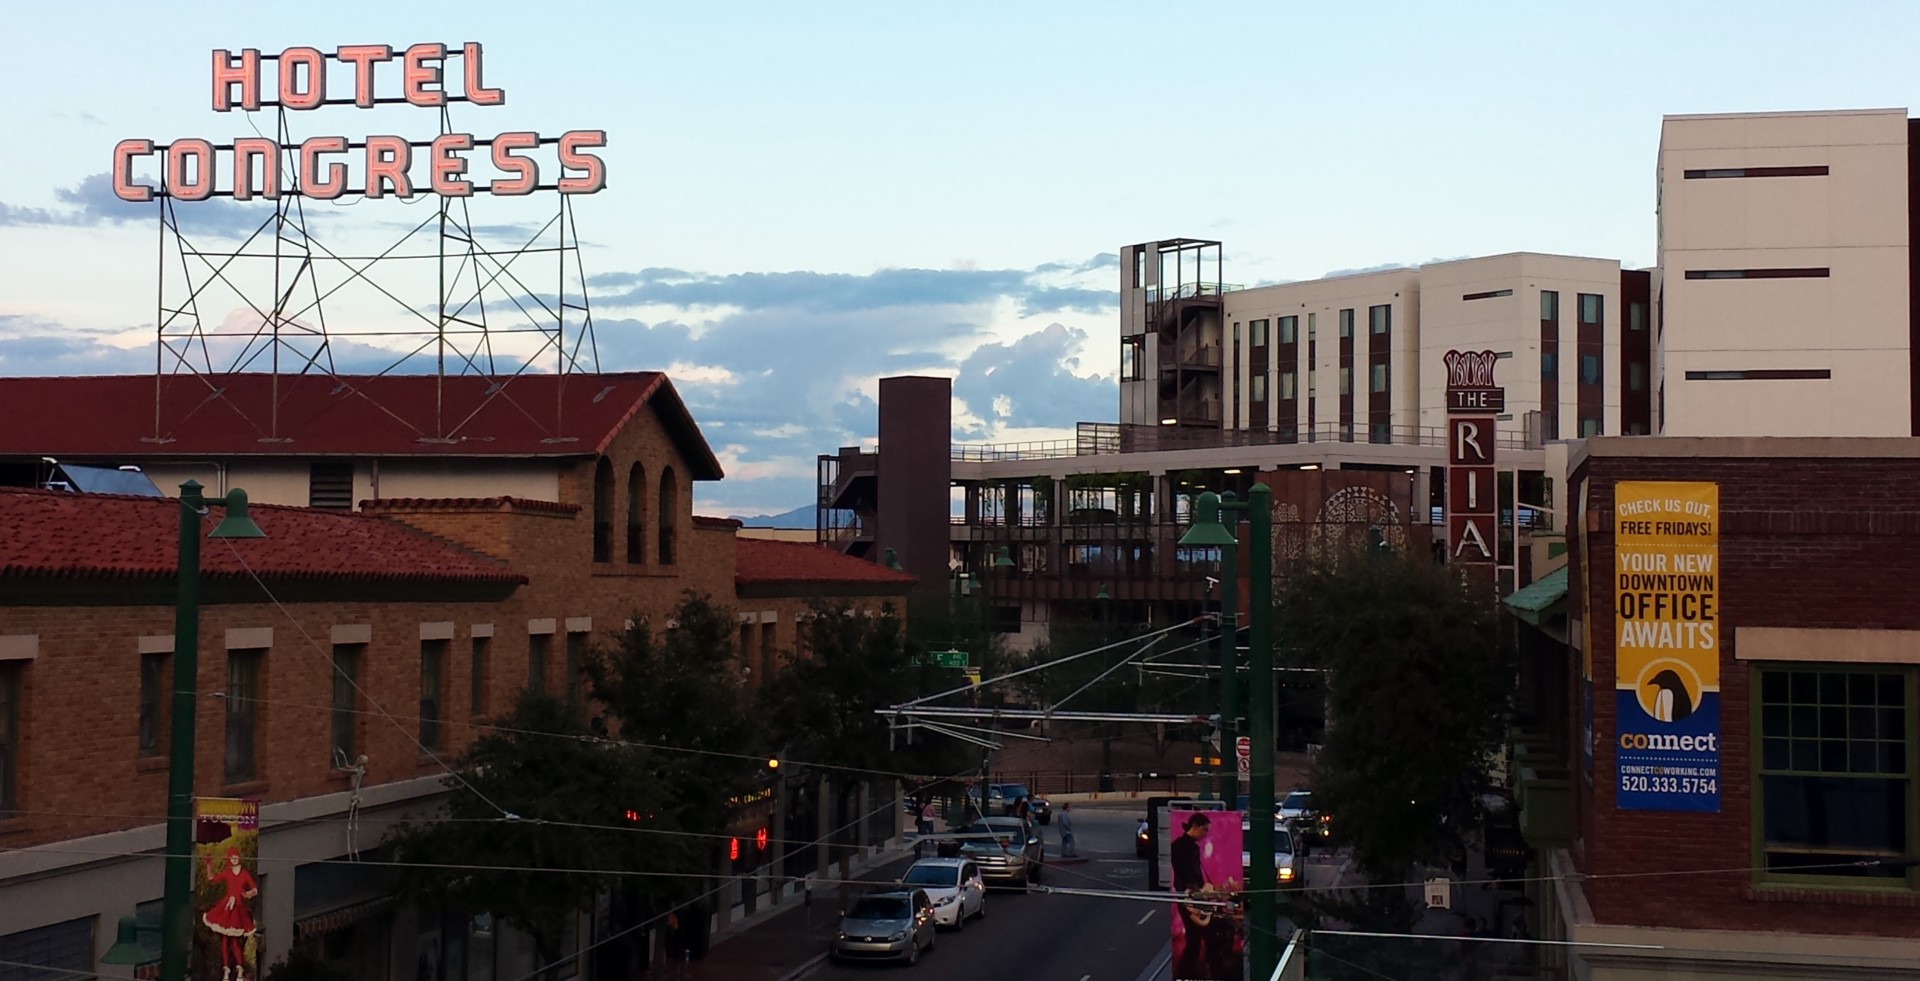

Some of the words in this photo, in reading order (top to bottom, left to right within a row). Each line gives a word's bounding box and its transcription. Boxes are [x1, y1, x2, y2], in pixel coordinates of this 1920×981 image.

[212, 42, 505, 111] HOTEL
[113, 130, 607, 201] CONGRESS
[1457, 391, 1487, 407] THE
[1455, 421, 1492, 595] RIA
[1619, 499, 1661, 517] CHECK
[1664, 499, 1681, 512] US
[1685, 501, 1712, 519] OUT,
[1620, 521, 1652, 535] FREE
[1656, 521, 1712, 536] FRIDAYS!
[1620, 553, 1667, 572] YOUR
[1673, 553, 1713, 573] NEW
[1620, 574, 1714, 591] DOWNTOWN
[1620, 592, 1714, 621] OFFICE
[1620, 620, 1714, 650] AWAITS
[1620, 732, 1717, 752] connect
[1620, 765, 1716, 777] CONNECTCOWORKING.COM
[1622, 776, 1717, 794] 520.333.5754
[200, 814, 256, 824] TUCSON
